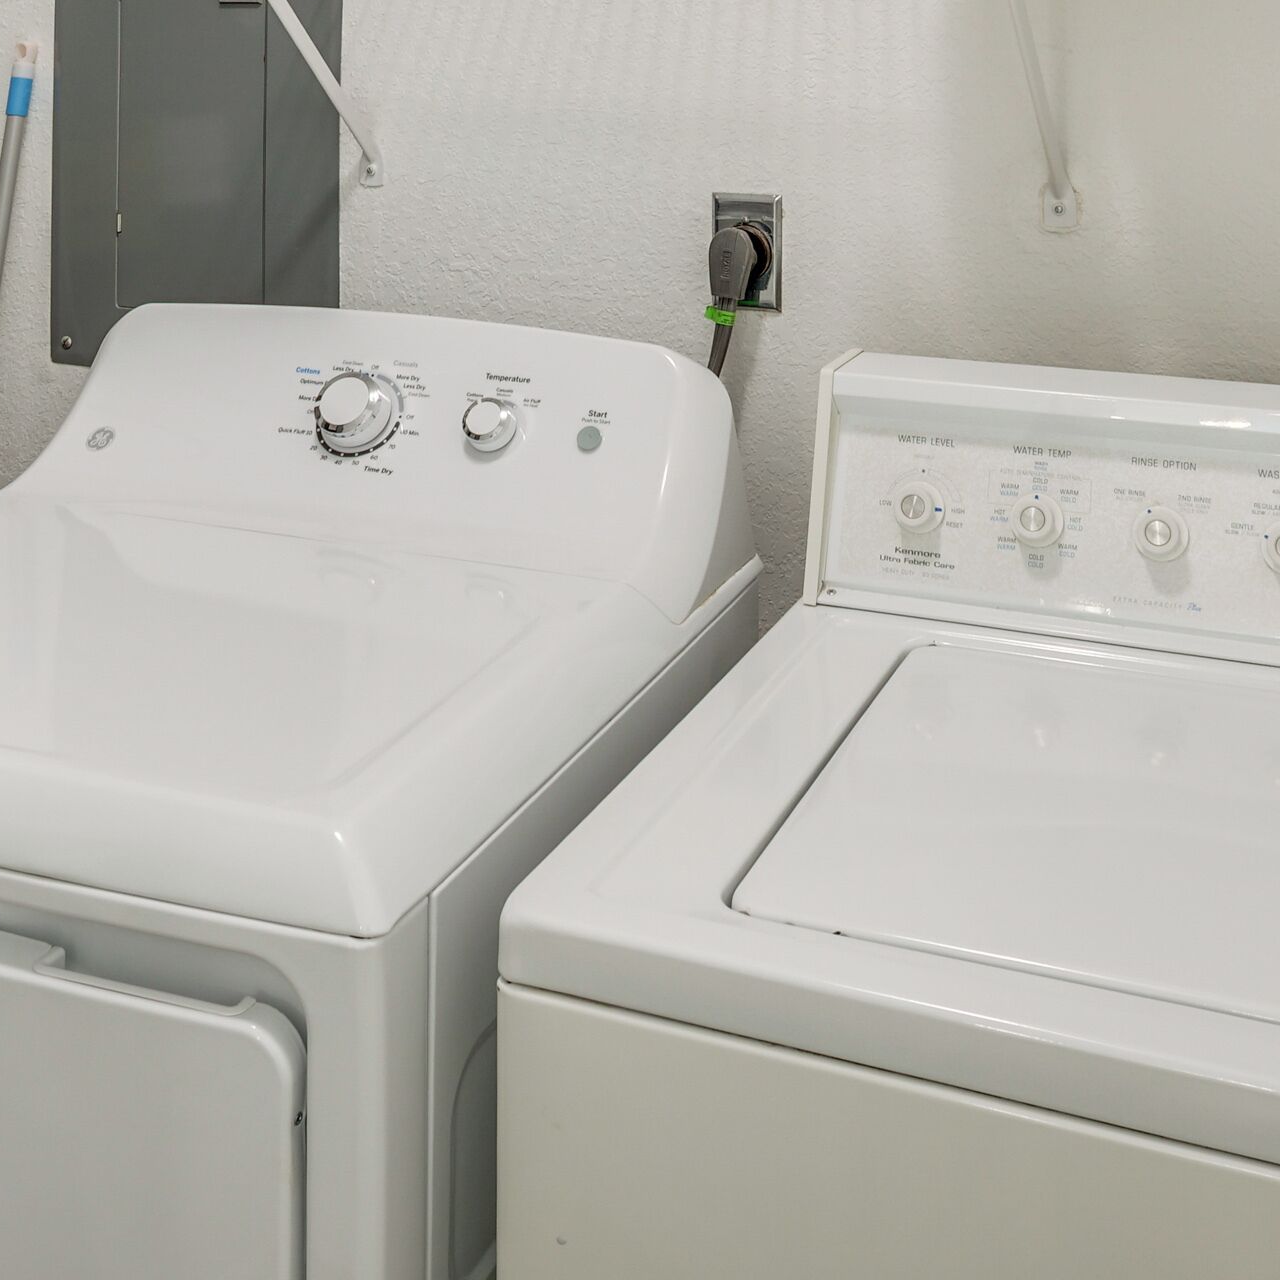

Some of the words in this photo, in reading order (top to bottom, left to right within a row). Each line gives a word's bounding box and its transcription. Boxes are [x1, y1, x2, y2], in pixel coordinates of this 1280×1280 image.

[393, 360, 418, 368] Casuals
[296, 366, 320, 375] Cottons
[300, 378, 323, 386] Optimum
[486, 372, 531, 384] Temperature
[588, 409, 608, 419] Start
[278, 427, 292, 435] Quick
[898, 434, 927, 445] WATER
[930, 437, 956, 448] LEVEL
[1013, 445, 1044, 456] WATER
[1048, 449, 1072, 458] TEMP
[1131, 457, 1158, 468] RINSE
[1162, 459, 1197, 471] OPTION
[363, 465, 380, 473] Time
[381, 467, 394, 476] Dry
[946, 521, 963, 529] RESET
[1231, 522, 1254, 531] GENTLE
[894, 546, 941, 559] Kenmore
[1028, 553, 1044, 561] COLD
[879, 554, 901, 564] Ultra
[903, 557, 931, 567] Fabric
[933, 561, 955, 570] Care
[1027, 561, 1044, 569] COLD
